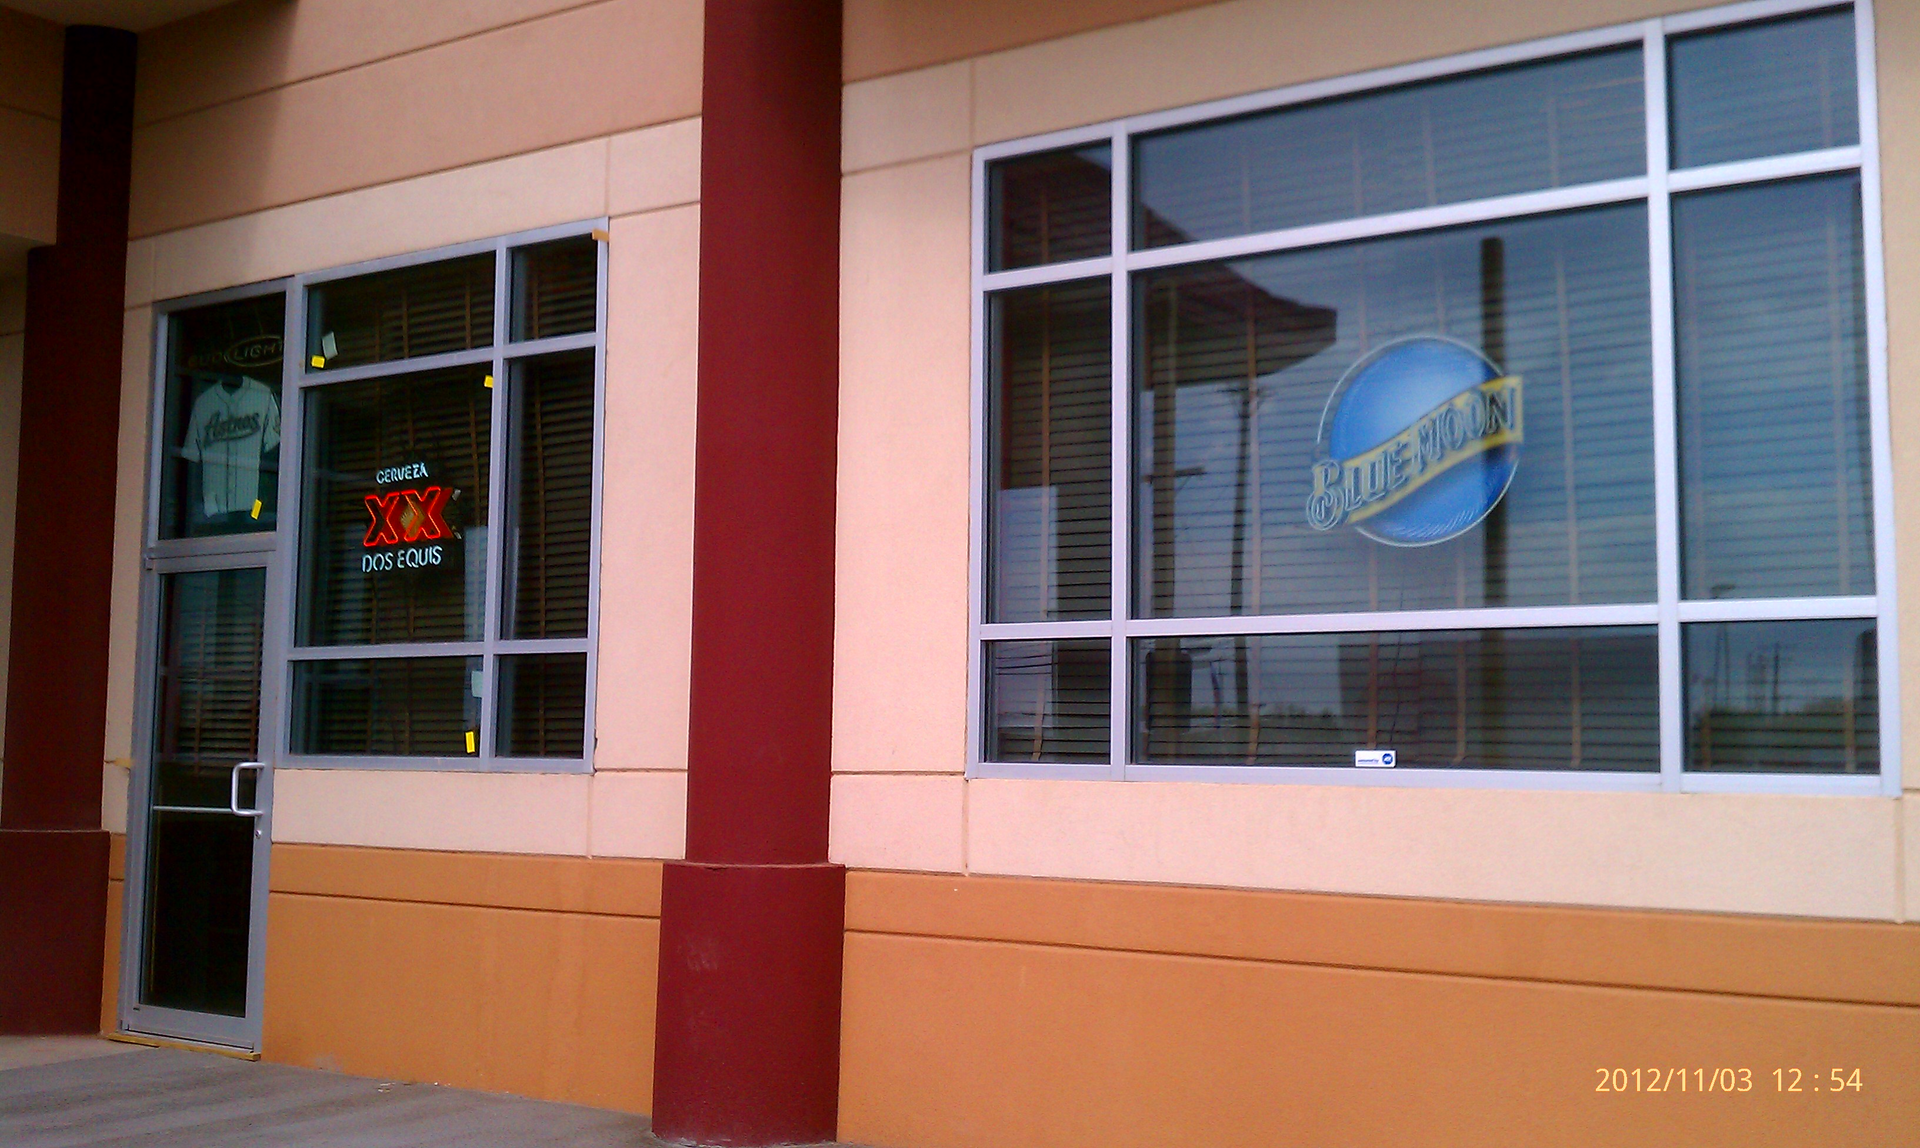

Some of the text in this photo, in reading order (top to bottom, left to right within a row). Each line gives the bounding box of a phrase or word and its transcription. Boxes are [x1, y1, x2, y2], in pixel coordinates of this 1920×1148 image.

[203, 410, 261, 449] Astros
[376, 462, 428, 484] CERVEZA
[1306, 386, 1518, 531] BLUE MOON
[363, 486, 446, 547] XX
[362, 545, 443, 573] DOS EQUIS
